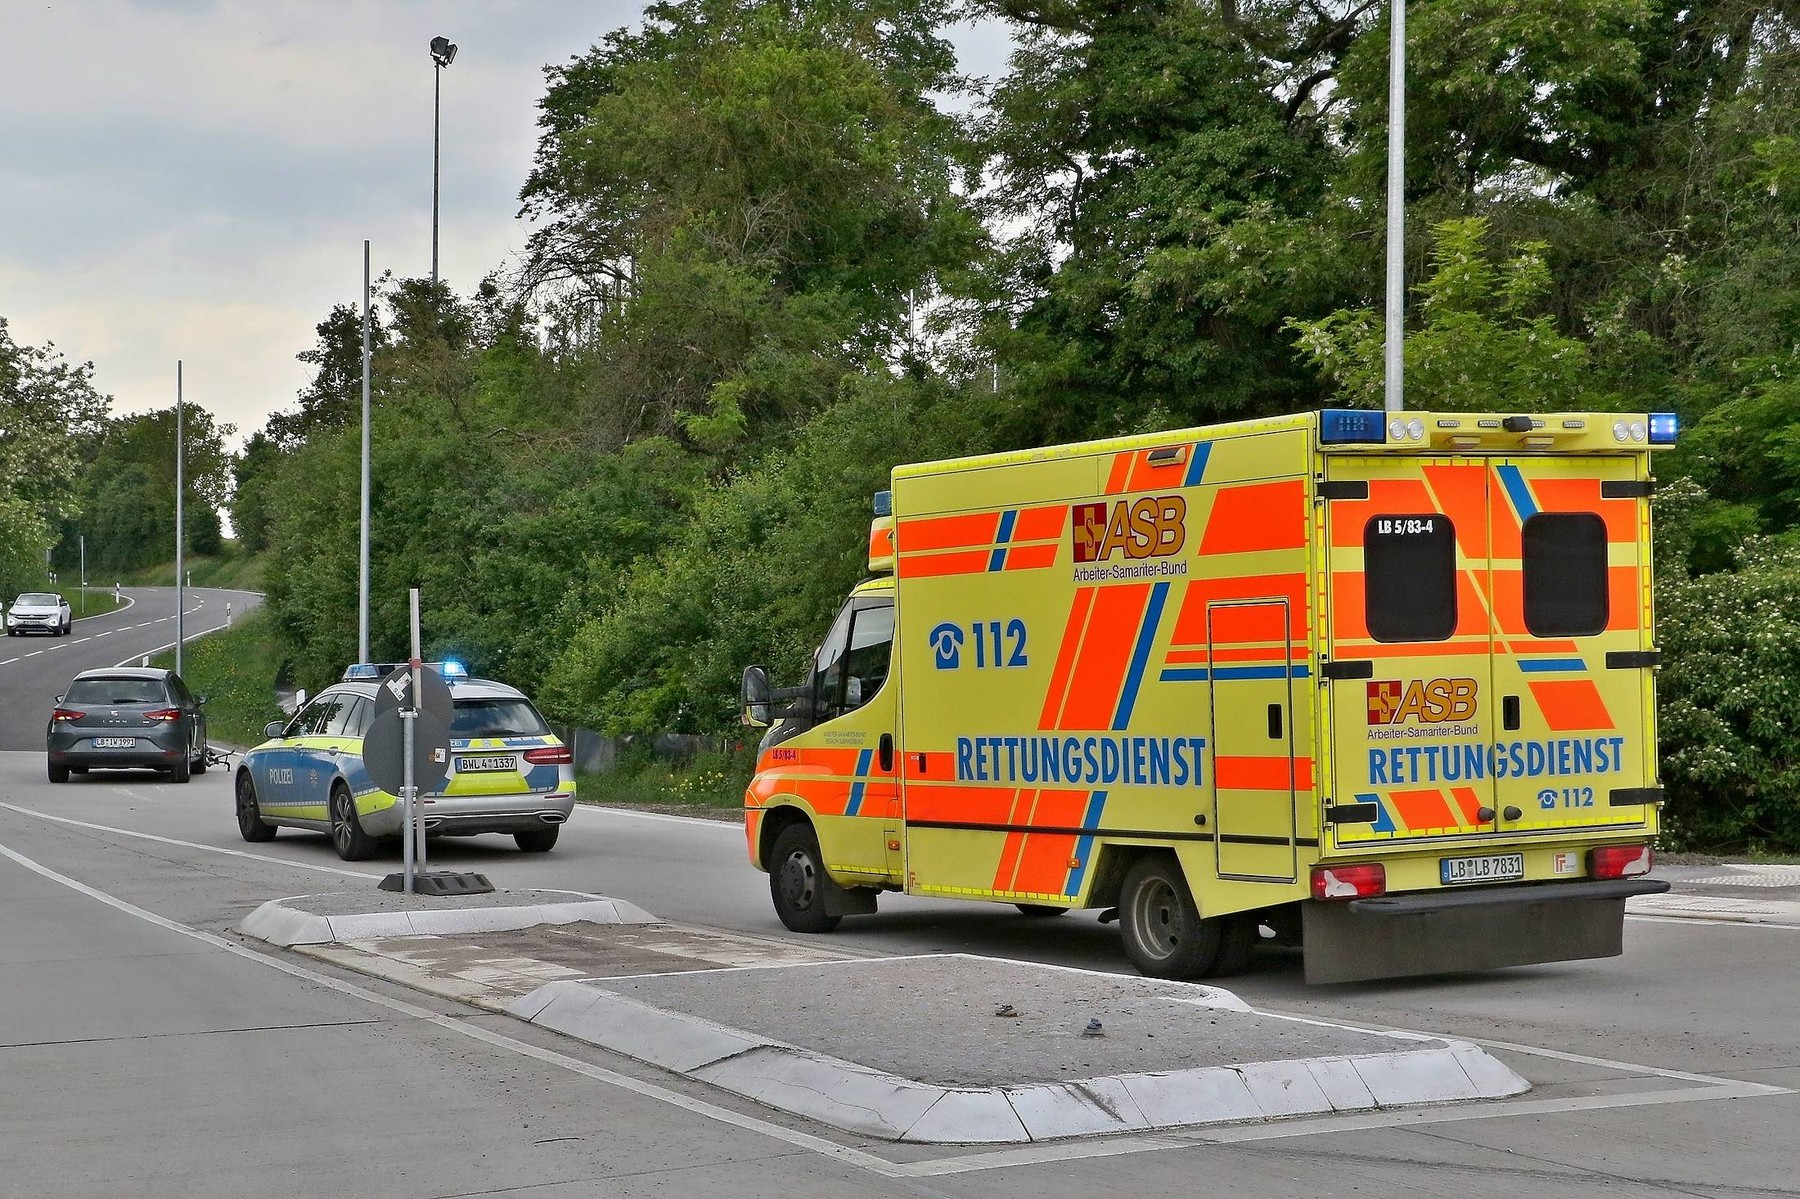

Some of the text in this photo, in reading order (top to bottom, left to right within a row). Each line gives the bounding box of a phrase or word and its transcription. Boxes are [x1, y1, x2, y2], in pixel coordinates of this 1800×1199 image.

[1098, 496, 1187, 562] ASB
[1378, 520, 1434, 535] LB 5/83-4
[1073, 560, 1187, 581] Arbeiter-Samariter-Bund
[972, 618, 1028, 668] 112
[1393, 678, 1478, 724] ASB
[1367, 724, 1478, 740] Arbeiter-Samariter-Bund
[462, 757, 515, 769] BWL 4 1337
[957, 736, 1206, 787] RETTUNGSDIENST
[1368, 737, 1624, 785] RETTUNGSDIENST
[270, 768, 294, 785] POLIZEI
[1563, 786, 1594, 808] 112
[1450, 861, 1466, 878] LB
[1474, 858, 1490, 876] LB
[1492, 856, 1522, 875] 7831
